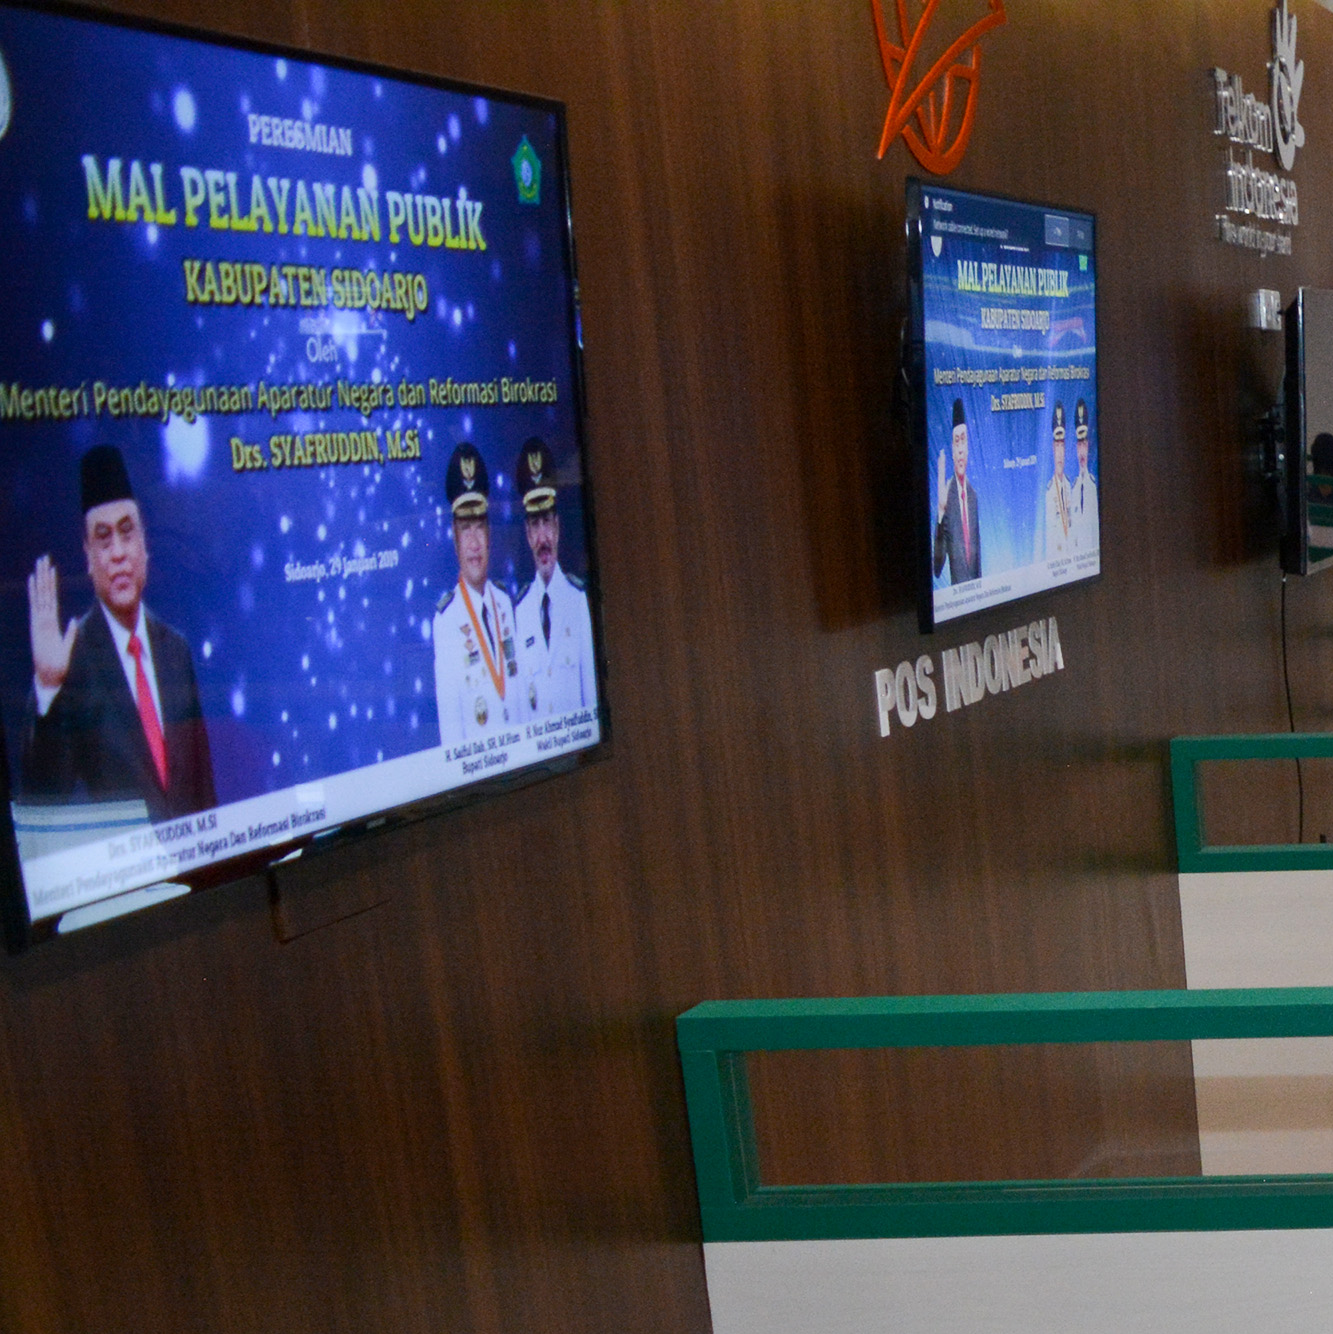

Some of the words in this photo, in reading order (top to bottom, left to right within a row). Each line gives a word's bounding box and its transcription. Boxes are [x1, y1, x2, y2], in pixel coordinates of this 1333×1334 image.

[248, 114, 352, 155] PERESMIAN
[1213, 67, 1274, 153] Telkom
[81, 154, 176, 225] MAL
[180, 166, 380, 242] PELAYANAN
[386, 191, 486, 250] PUBLIK
[1225, 146, 1299, 226] Indonesia
[183, 259, 327, 306] KABUPATEN
[330, 268, 428, 320] SIDOARJO
[957, 260, 980, 291] MAL
[981, 262, 1037, 295] PELAYANAN
[1038, 268, 1069, 297] PUBLIK
[306, 337, 338, 362] Oleh
[0, 381, 88, 419] Menteri
[93, 381, 253, 424] Pendayagunaan
[257, 381, 332, 418] Aparatur
[337, 381, 394, 417] Negara
[399, 379, 426, 406] dan
[429, 378, 498, 405] Reformasi
[501, 377, 557, 402] Birokrasi
[230, 437, 268, 470] Drs.
[269, 433, 384, 468] SYAFRUDDIN,
[386, 429, 420, 460] M.Si
[874, 654, 937, 737] POS
[942, 617, 1065, 713] INDONESIA
